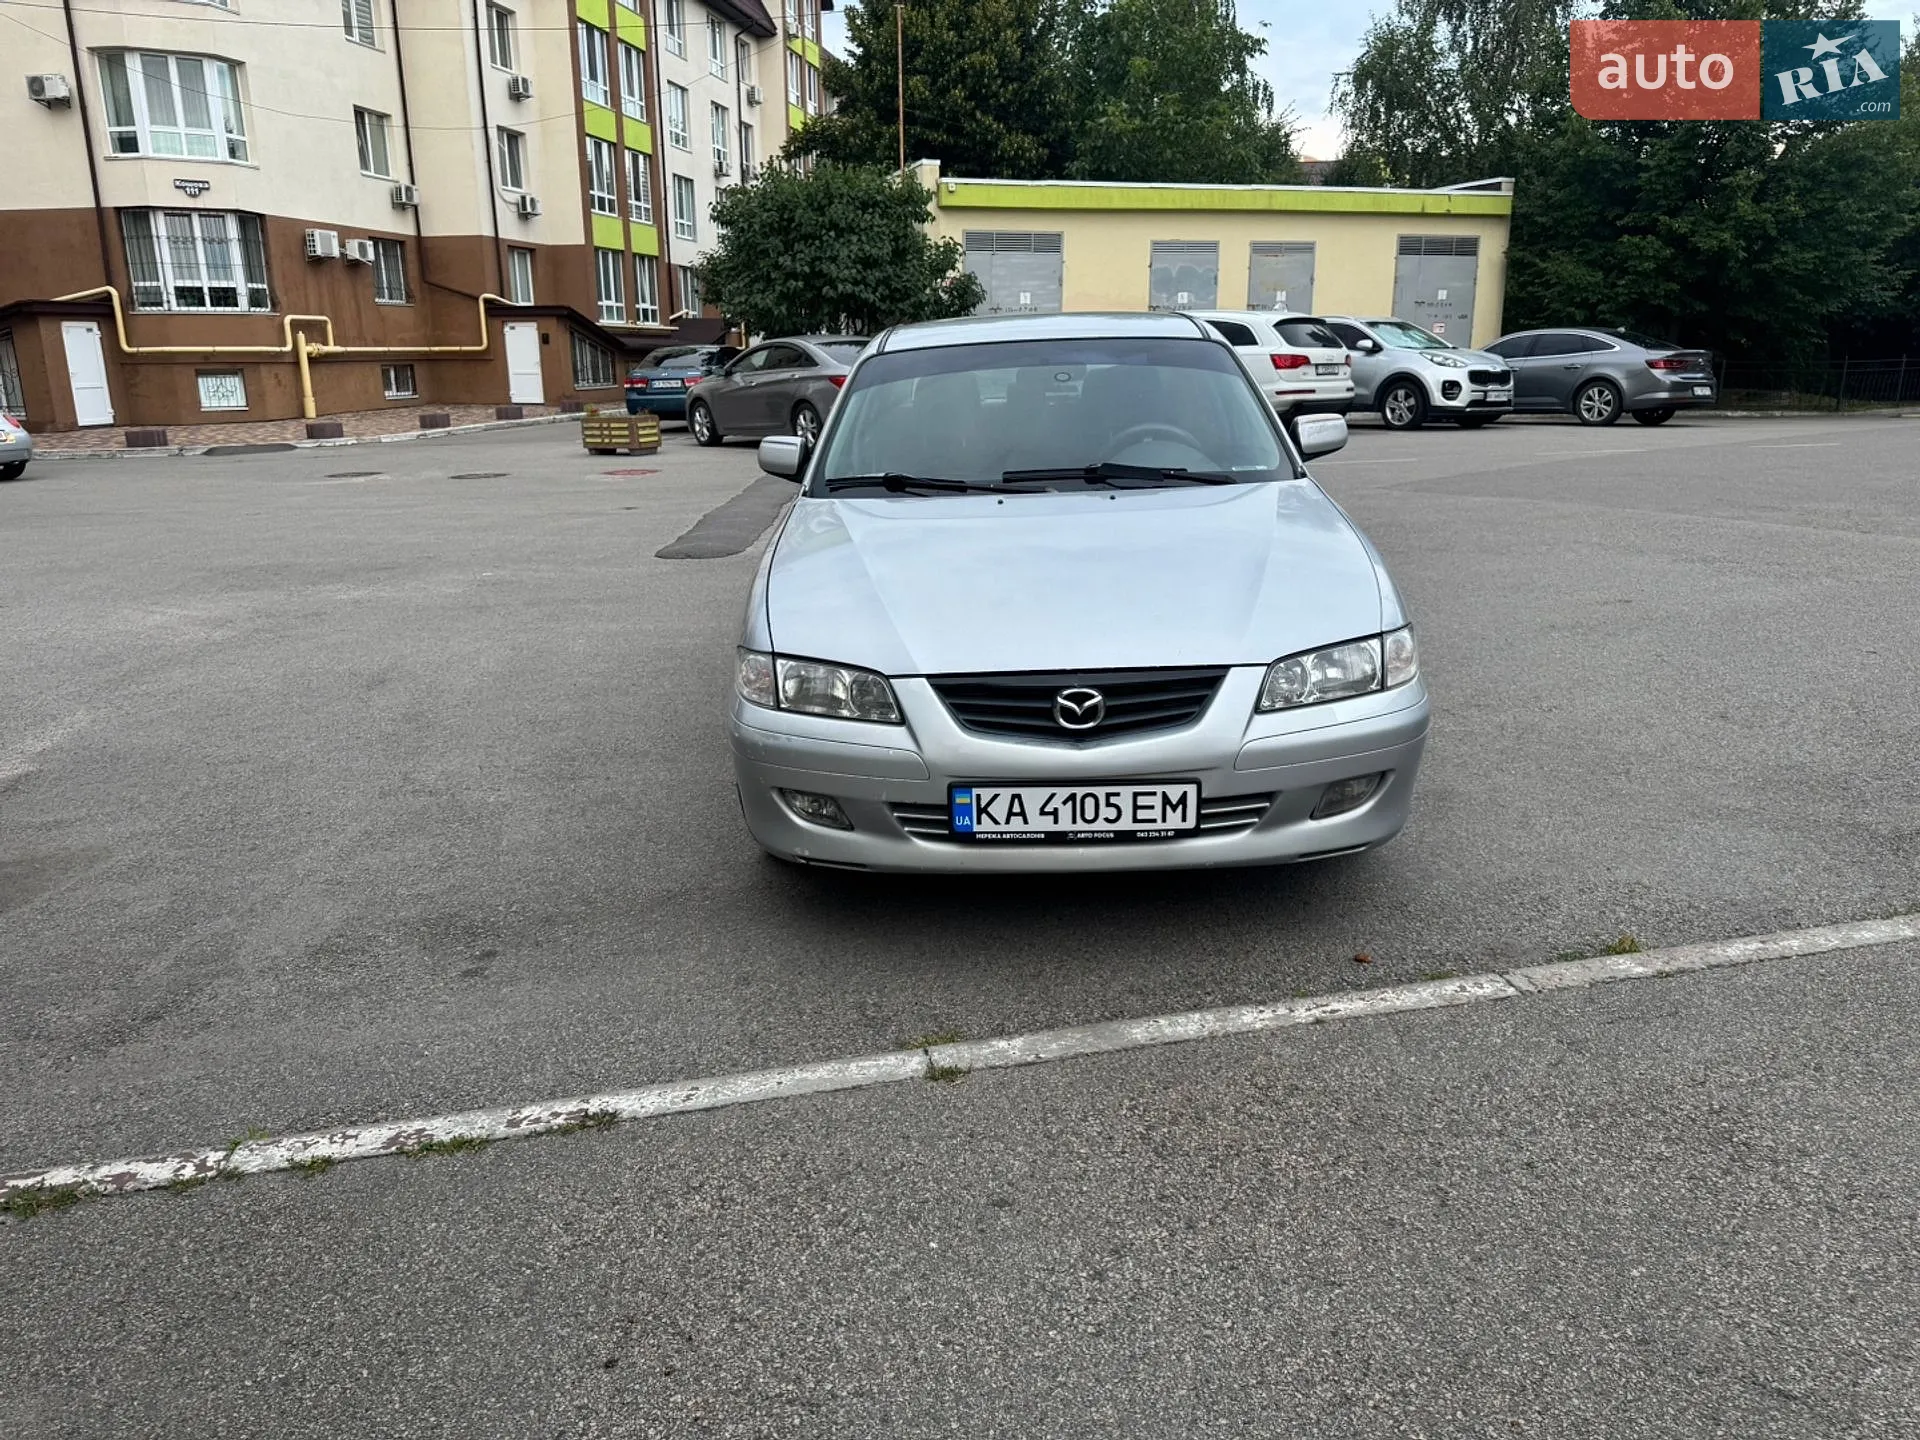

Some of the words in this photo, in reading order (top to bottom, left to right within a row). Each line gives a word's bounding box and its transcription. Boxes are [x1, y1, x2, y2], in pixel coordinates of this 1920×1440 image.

[975, 793, 1029, 825] KA
[1039, 792, 1122, 825] 4105
[1132, 791, 1188, 824] EM
[955, 815, 971, 826] UA
